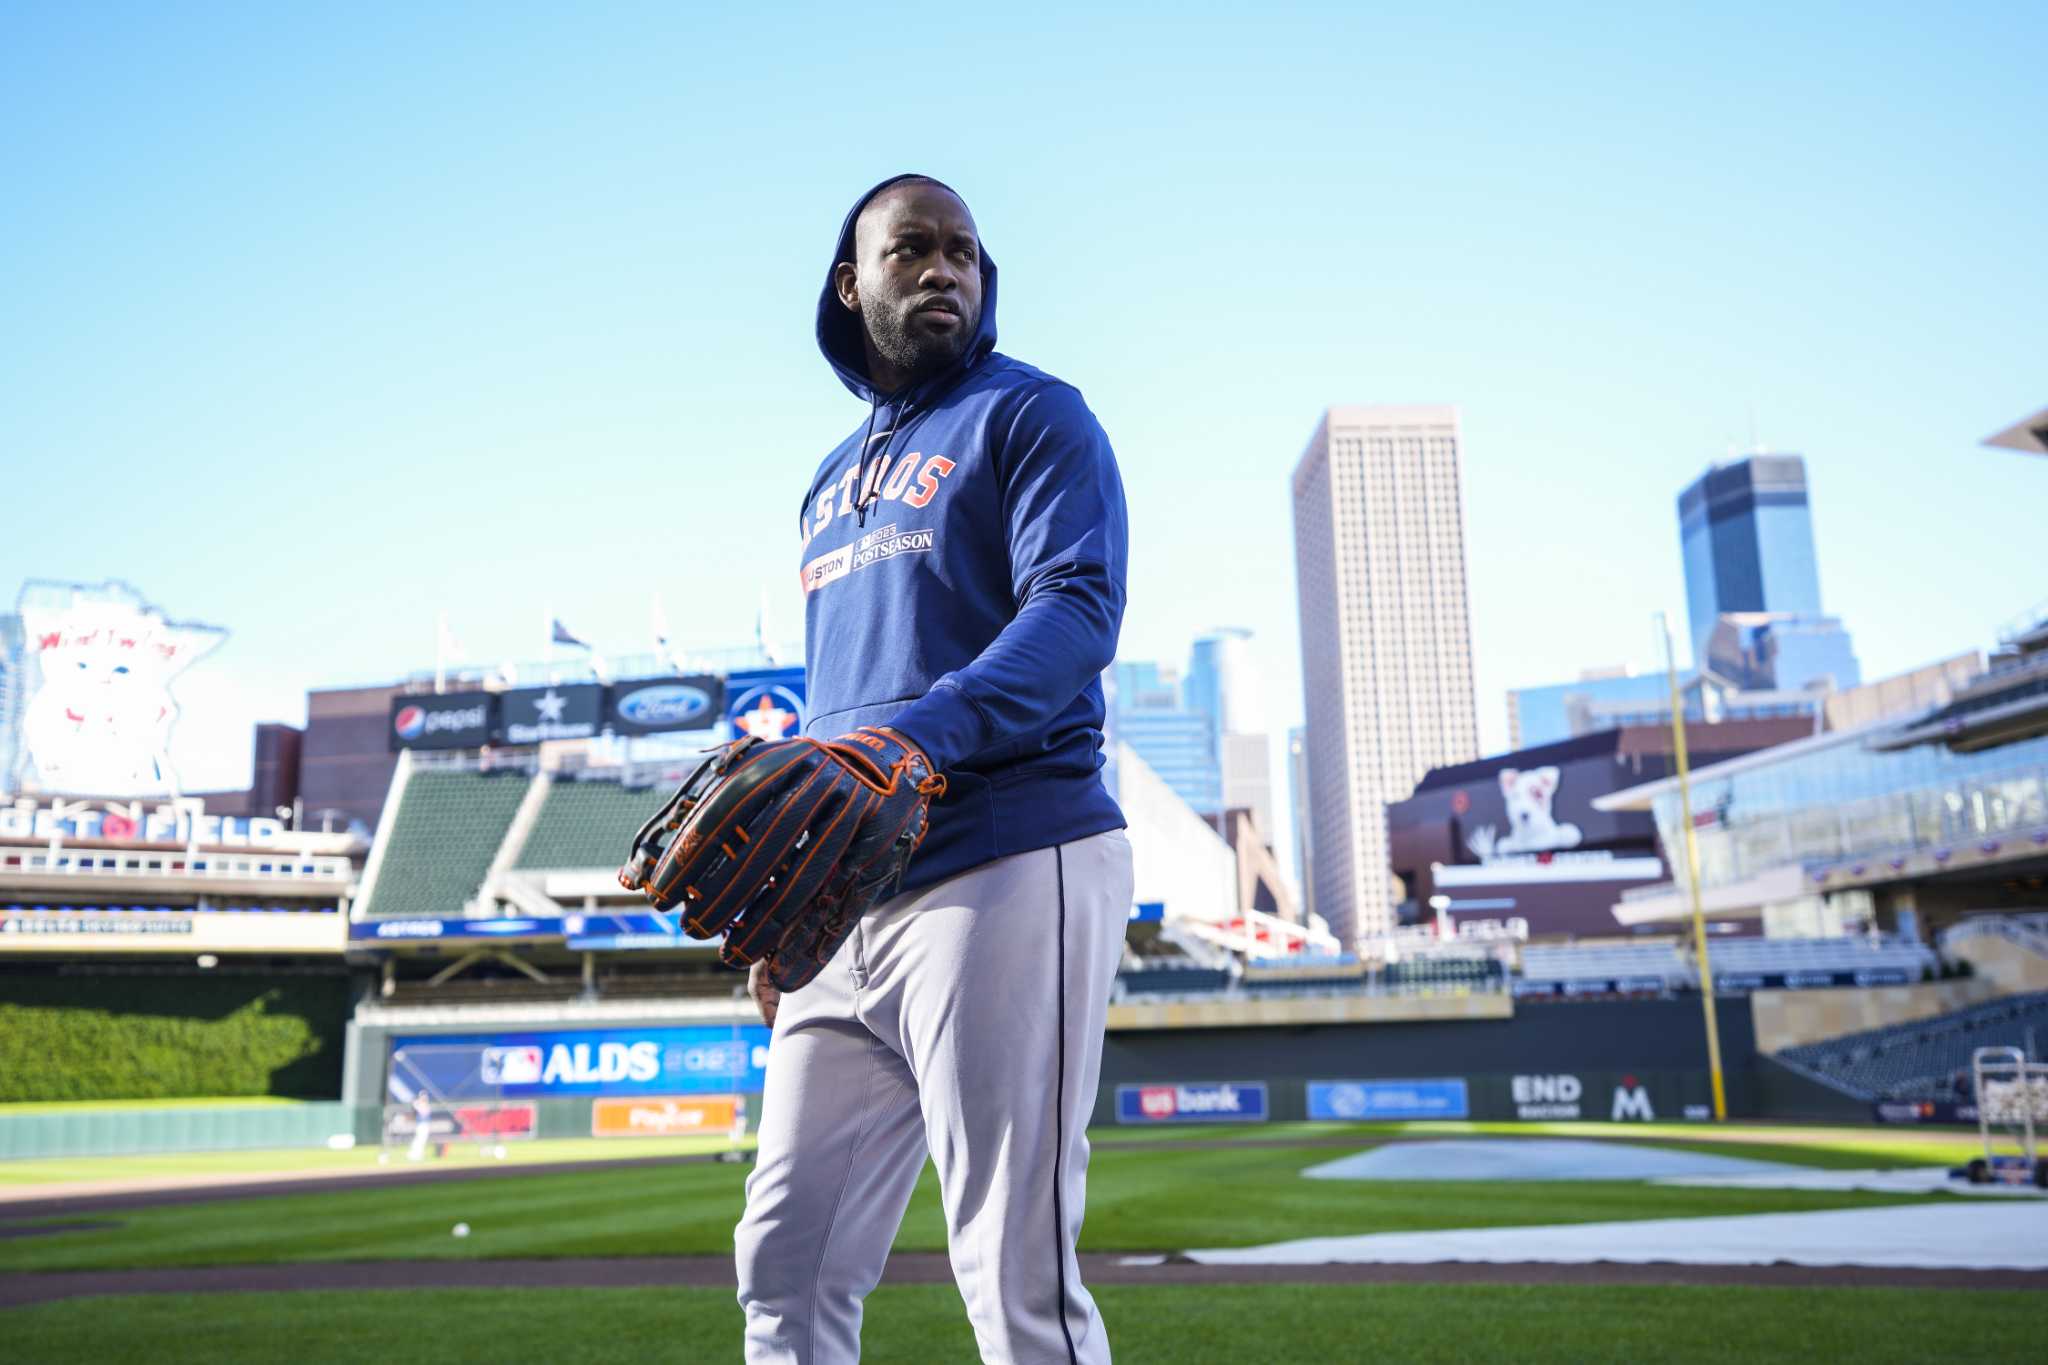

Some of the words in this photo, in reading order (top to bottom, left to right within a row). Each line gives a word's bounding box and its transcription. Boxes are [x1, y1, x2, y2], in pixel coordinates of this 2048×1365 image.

[853, 533, 933, 568] POSTSEASON
[803, 556, 844, 582] USTON
[425, 704, 487, 735] pepsi
[635, 696, 691, 720] Ford
[542, 1041, 661, 1084] ALDS
[1176, 1084, 1241, 1113] bank
[1511, 1074, 1583, 1104] END
